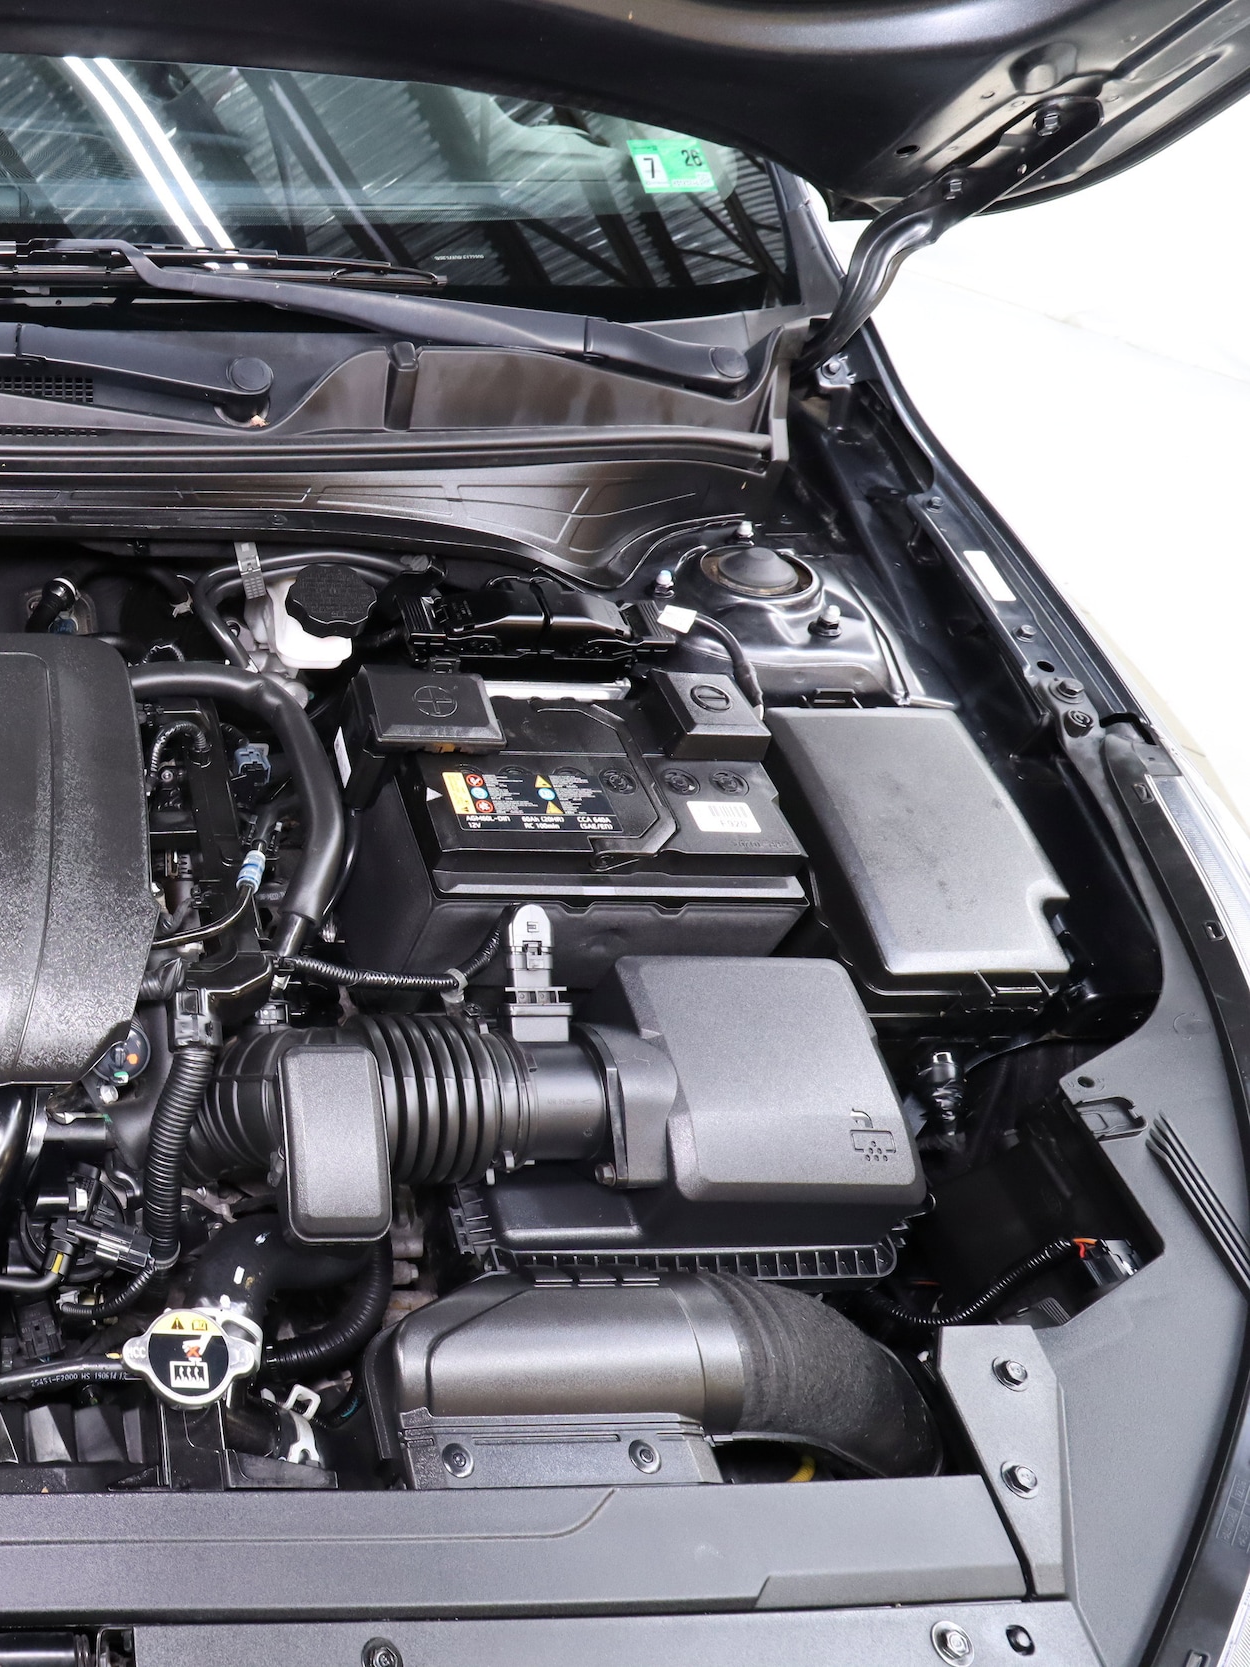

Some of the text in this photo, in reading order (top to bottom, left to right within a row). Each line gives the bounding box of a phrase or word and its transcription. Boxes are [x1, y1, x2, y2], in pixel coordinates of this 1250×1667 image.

[681, 149, 703, 166] 26
[643, 157, 655, 179] 7
[81, 1372, 91, 1380] HS
